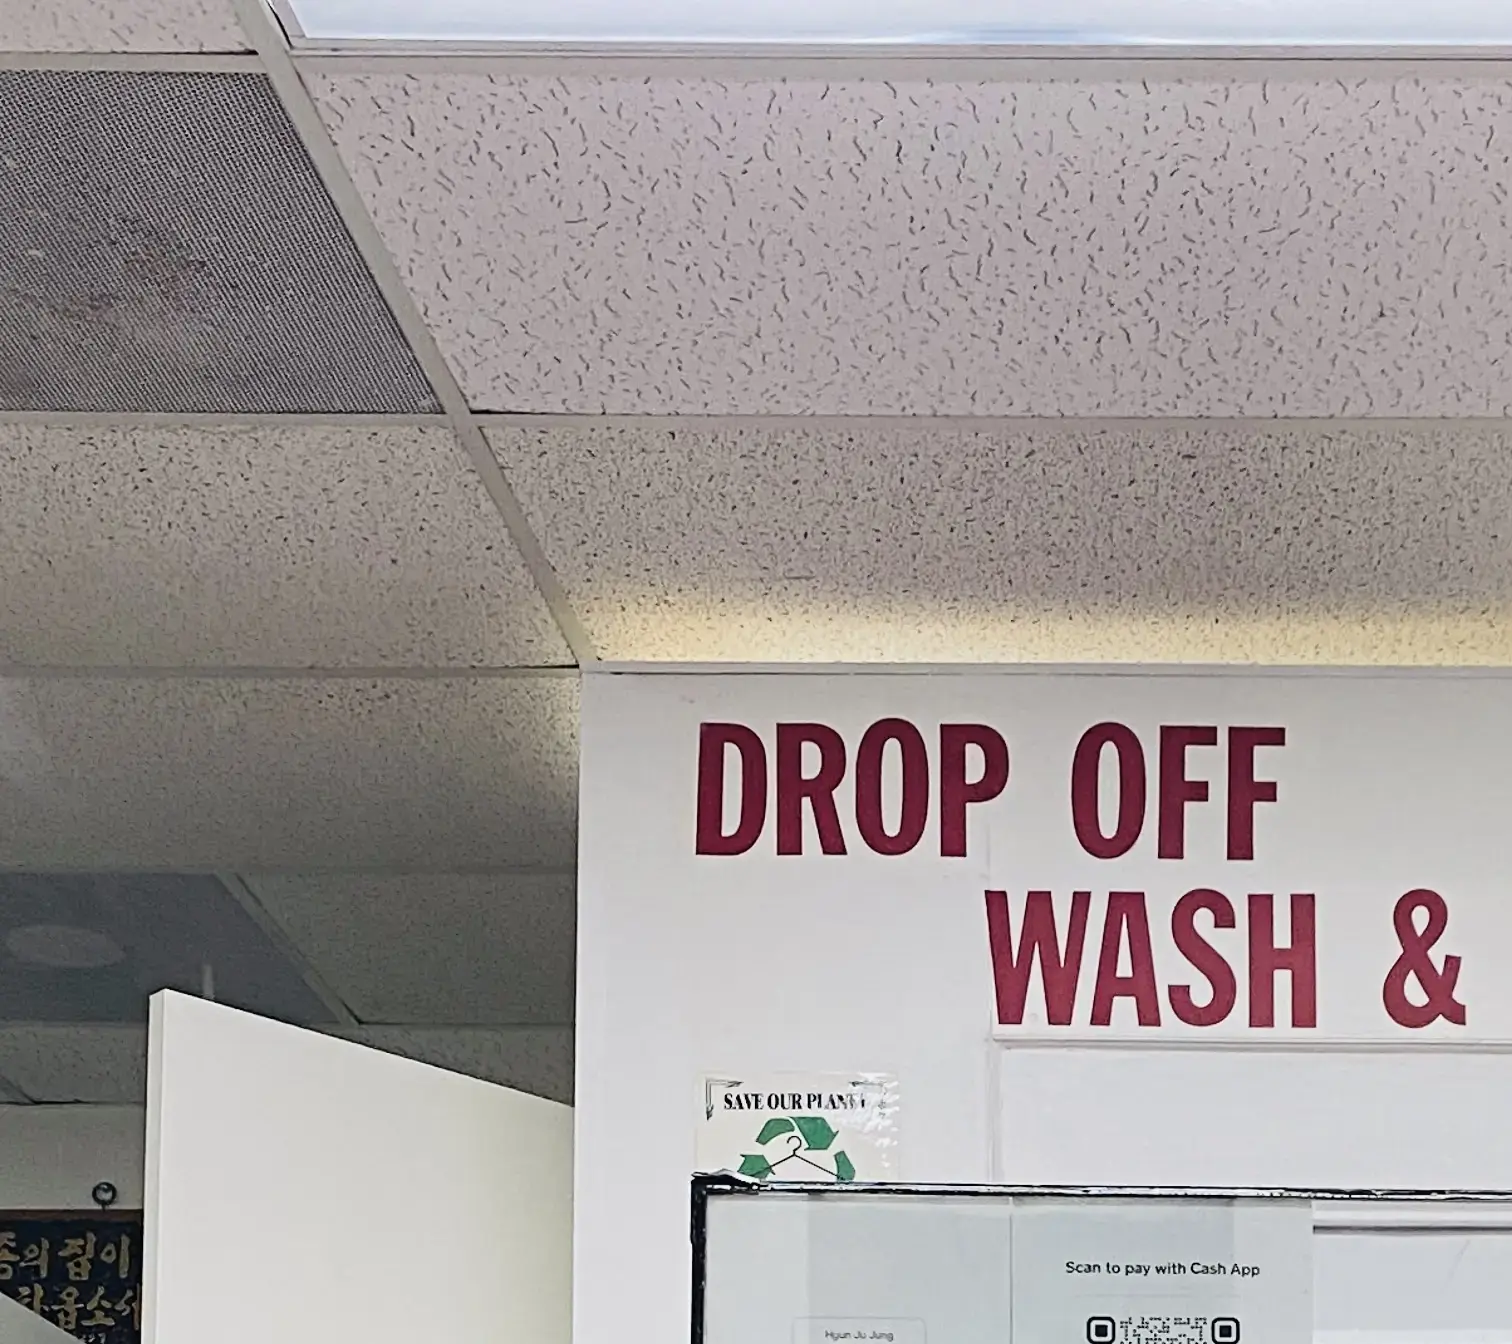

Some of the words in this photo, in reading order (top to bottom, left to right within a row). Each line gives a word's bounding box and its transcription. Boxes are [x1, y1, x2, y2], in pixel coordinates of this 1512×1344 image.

[695, 718, 1009, 857] DROP
[1071, 721, 1287, 860] OFF
[984, 888, 1317, 1029] WASH
[1382, 888, 1467, 1029] &
[723, 1092, 764, 1111] SAVE
[767, 1092, 803, 1111] OUR
[1065, 1261, 1101, 1274] Scan
[1106, 1261, 1121, 1275] to
[1125, 1263, 1151, 1277] pay
[1155, 1261, 1187, 1275] with
[1190, 1261, 1227, 1276] Cash
[1230, 1262, 1261, 1278] App
